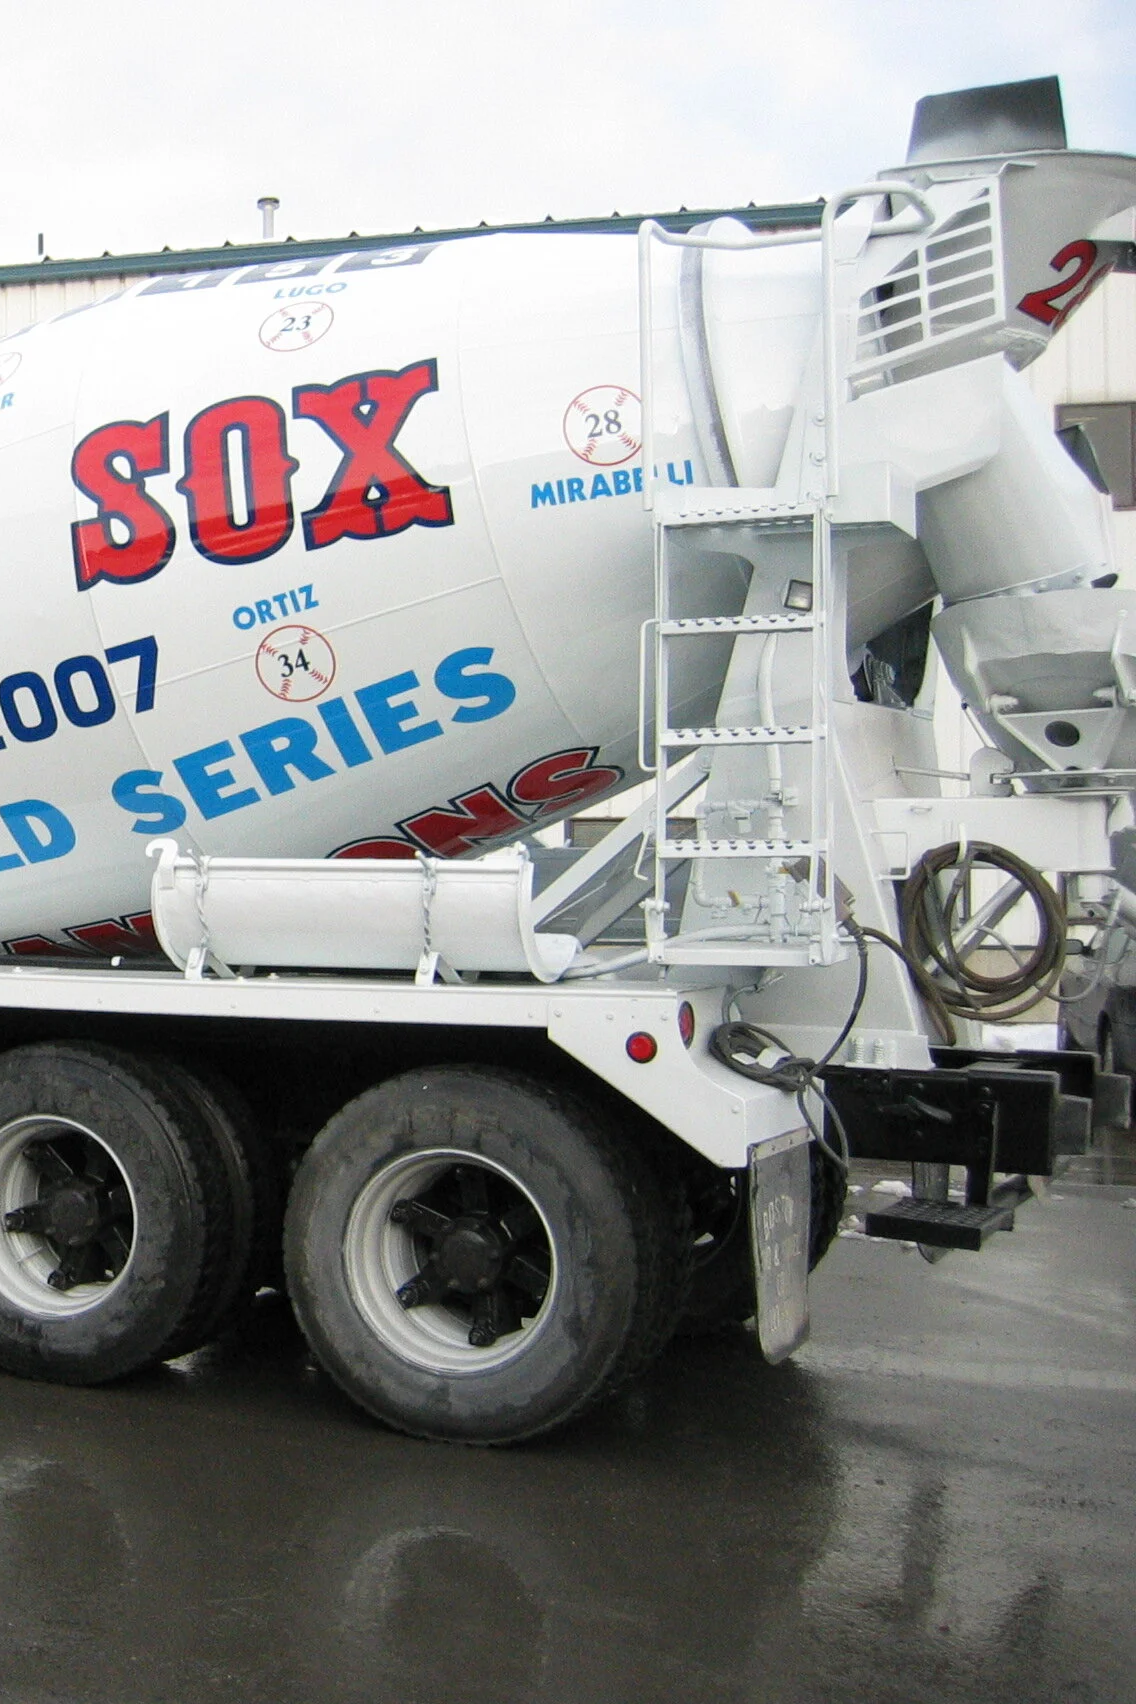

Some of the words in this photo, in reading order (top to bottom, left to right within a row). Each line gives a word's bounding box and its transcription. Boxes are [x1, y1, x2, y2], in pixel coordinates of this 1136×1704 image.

[272, 281, 348, 300] LUGO
[1015, 239, 1106, 328] 2
[279, 315, 313, 332] 23
[585, 409, 623, 438] 28
[71, 358, 455, 591] SOX
[531, 459, 695, 509] MIRABELI
[232, 584, 320, 630] ORTIZ
[277, 648, 312, 678] 34
[111, 646, 517, 835] SERIES
